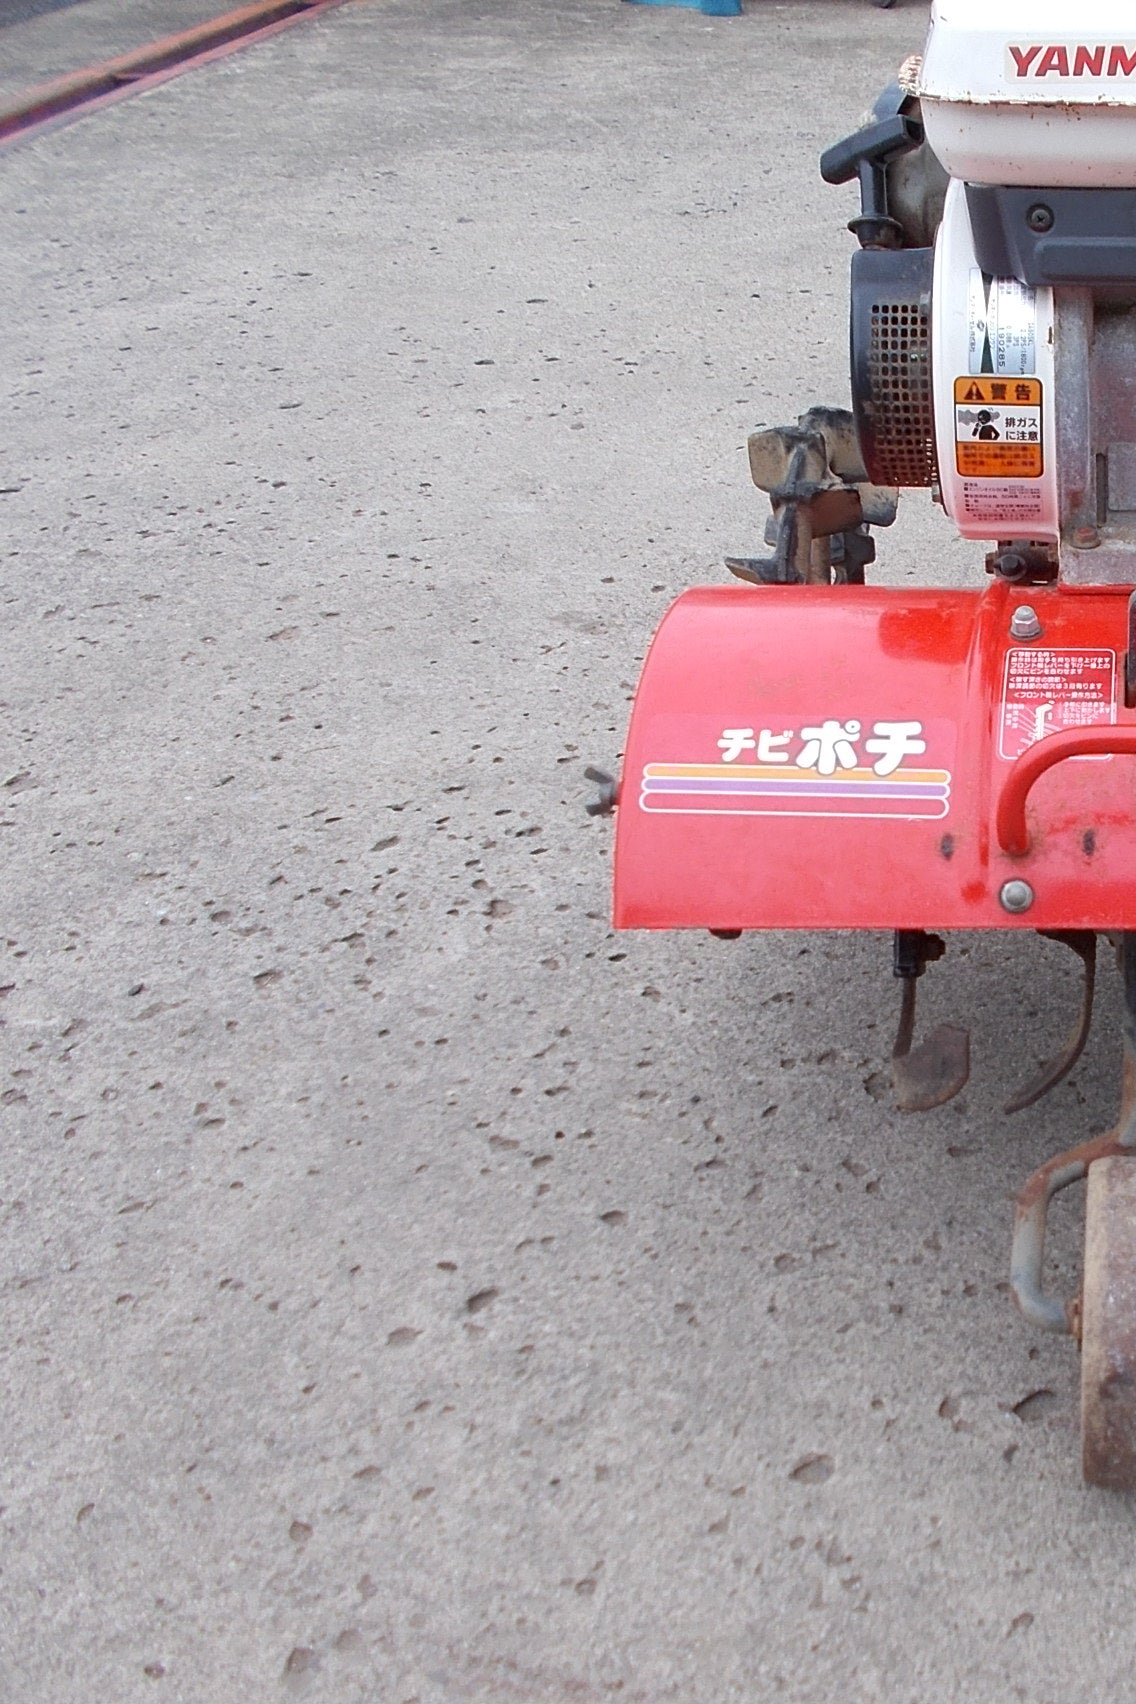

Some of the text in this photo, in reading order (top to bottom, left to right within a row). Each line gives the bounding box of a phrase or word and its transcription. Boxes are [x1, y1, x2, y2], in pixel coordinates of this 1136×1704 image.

[998, 327, 1006, 367] 190285
[990, 383, 1031, 400] 警告
[1005, 417, 1038, 428] 排ガス
[1005, 430, 1039, 441] に注意
